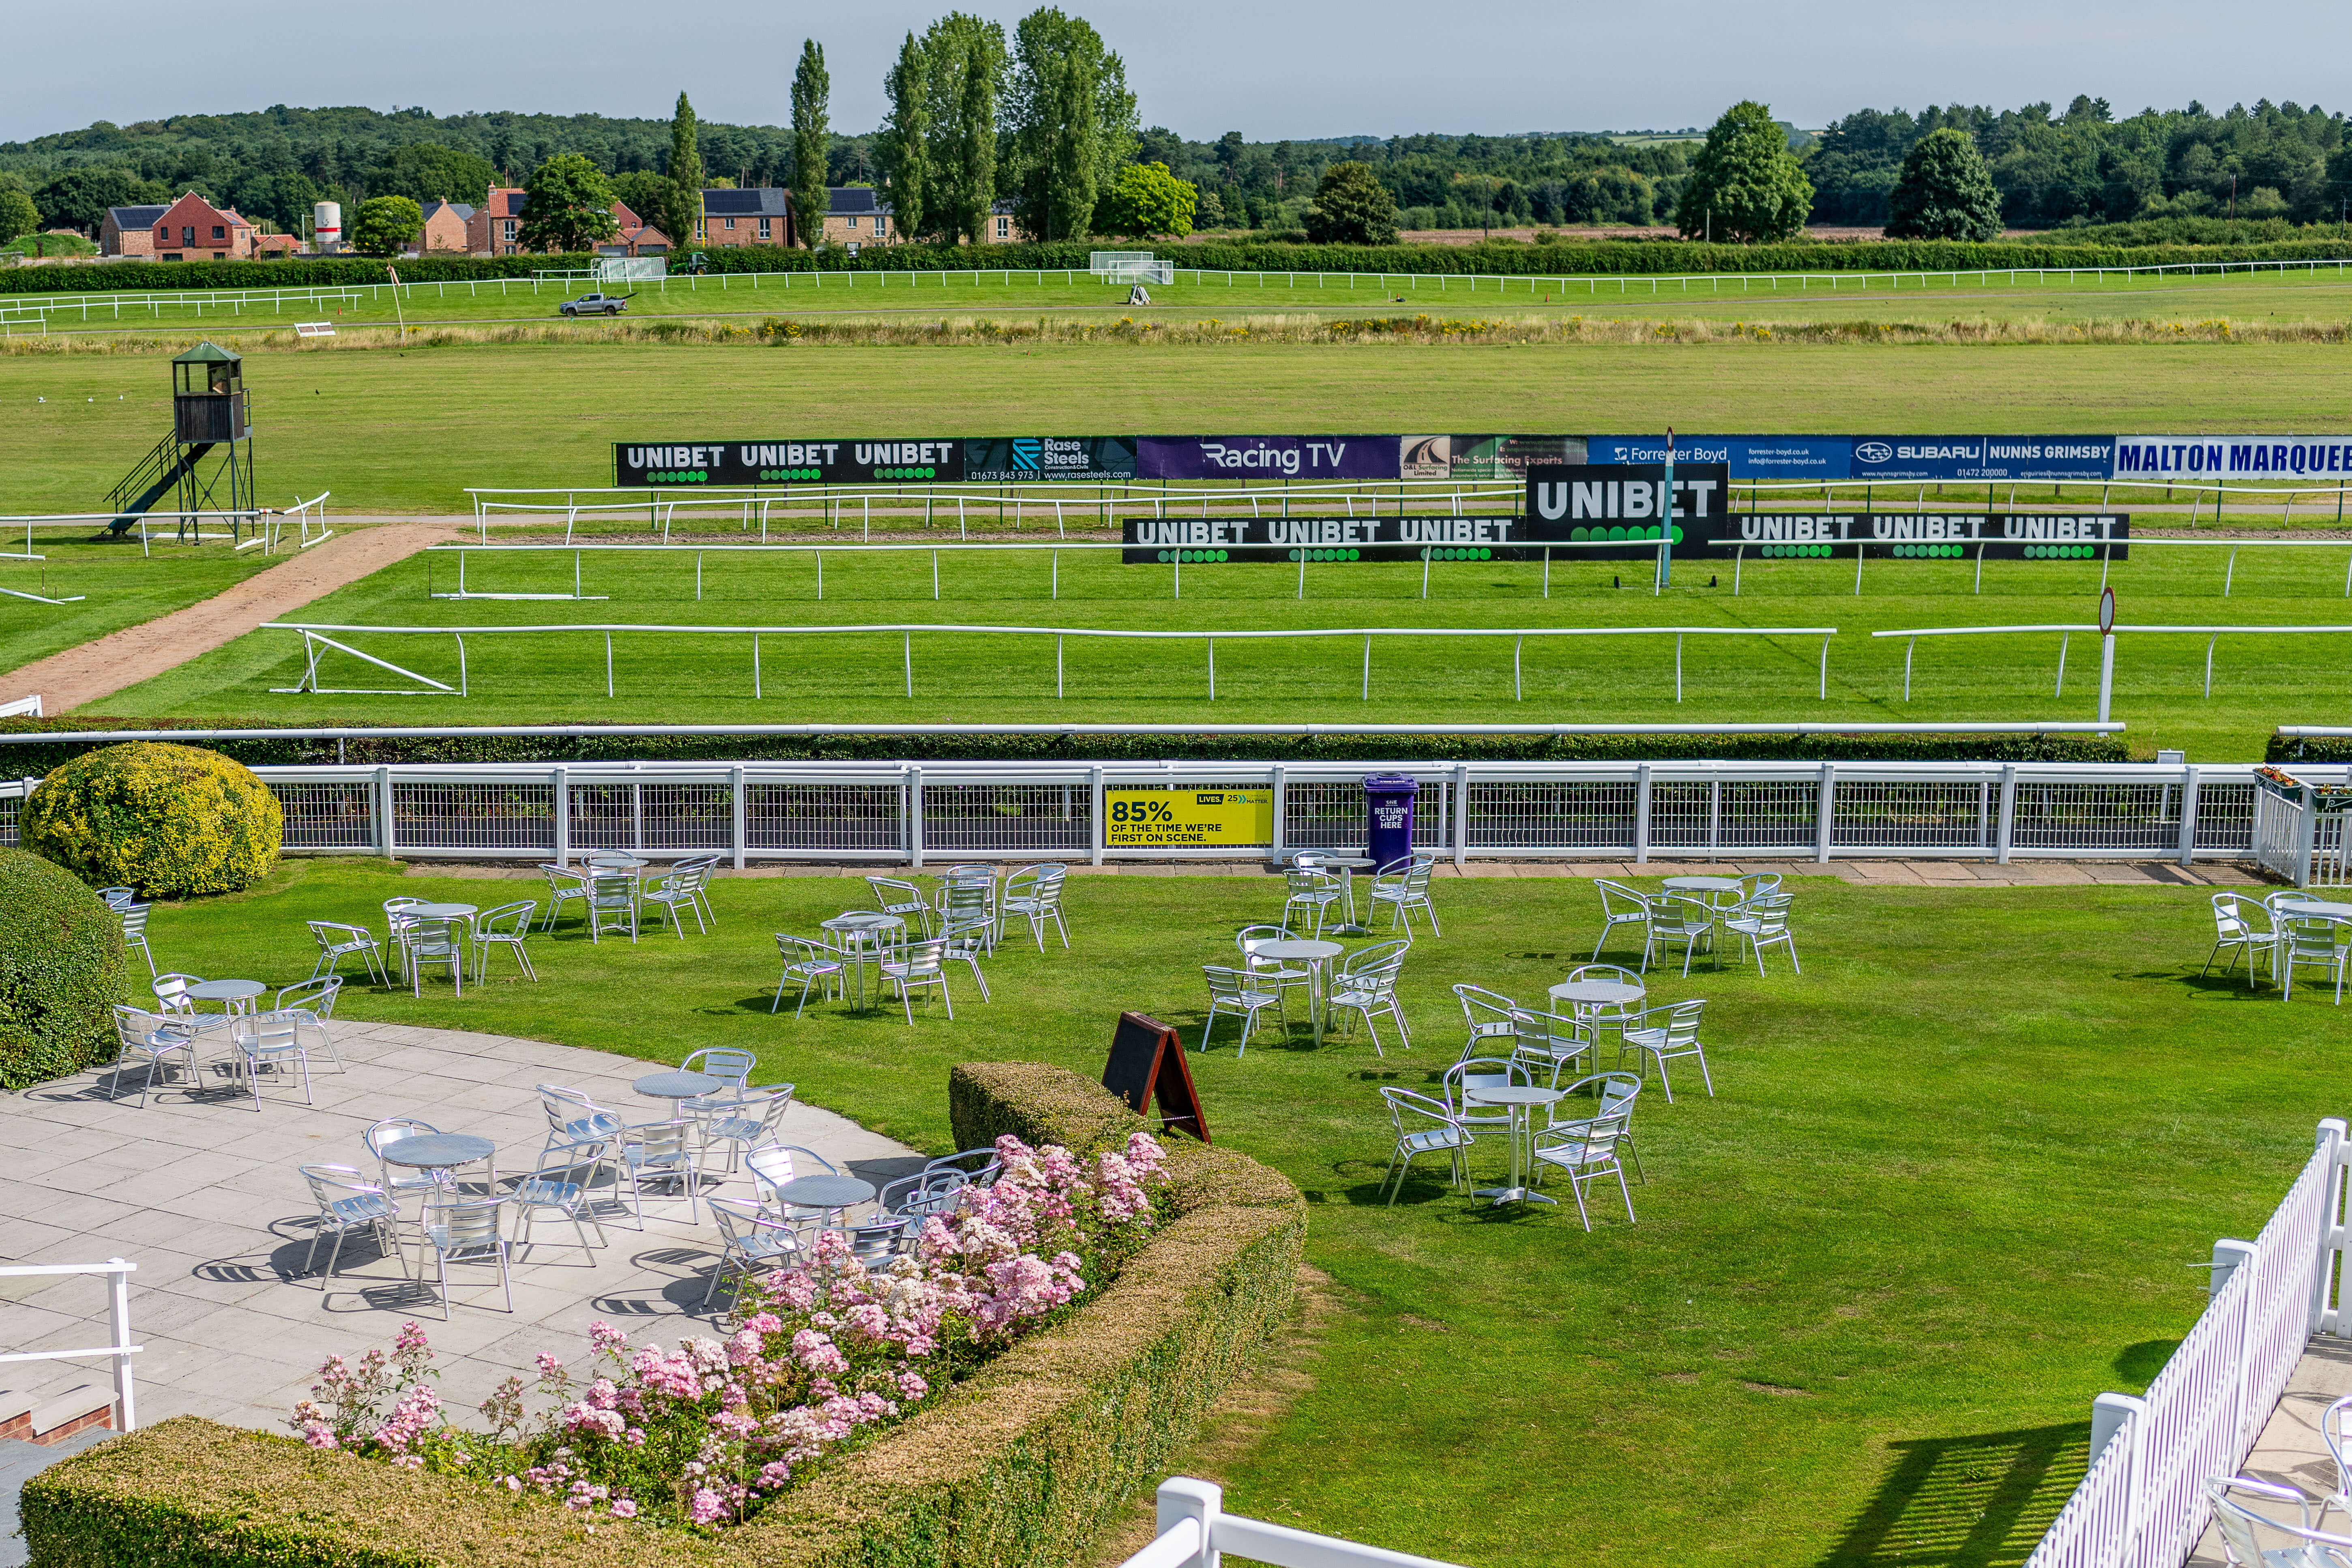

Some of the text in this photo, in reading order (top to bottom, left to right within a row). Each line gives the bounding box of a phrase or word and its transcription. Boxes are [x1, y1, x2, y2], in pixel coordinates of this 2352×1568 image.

[1045, 438, 1081, 451] Rase
[628, 443, 953, 468] UNIBET UNIBET UNIBET
[1044, 451, 1089, 465] Steels
[1200, 442, 1346, 474] Racing TV
[1631, 447, 1727, 463] Forreter Boyd
[1749, 448, 1809, 456] forrester-boyd.co.uk
[1897, 446, 1979, 459] SUBARU
[1990, 446, 2110, 459] NUNNS GRIMSBY
[2118, 445, 2223, 472] MALTON
[1451, 455, 1562, 466] The Surfacing Experts
[1748, 458, 1826, 466] info@forrester-boyd.co.uk
[1018, 471, 1033, 479] 973
[1044, 470, 1131, 479] www.rasesteels.com
[1538, 480, 1717, 520] UNIBET
[1137, 519, 1513, 544] UNIBET UNIBET UNIBET
[1741, 517, 2116, 540] UNIBET UNIBET UNIBET
[1112, 801, 1173, 822] 85%
[1111, 824, 1222, 832] OF THE TIME WE'RE
[1111, 833, 1206, 842] FIRST ON SCENE.
